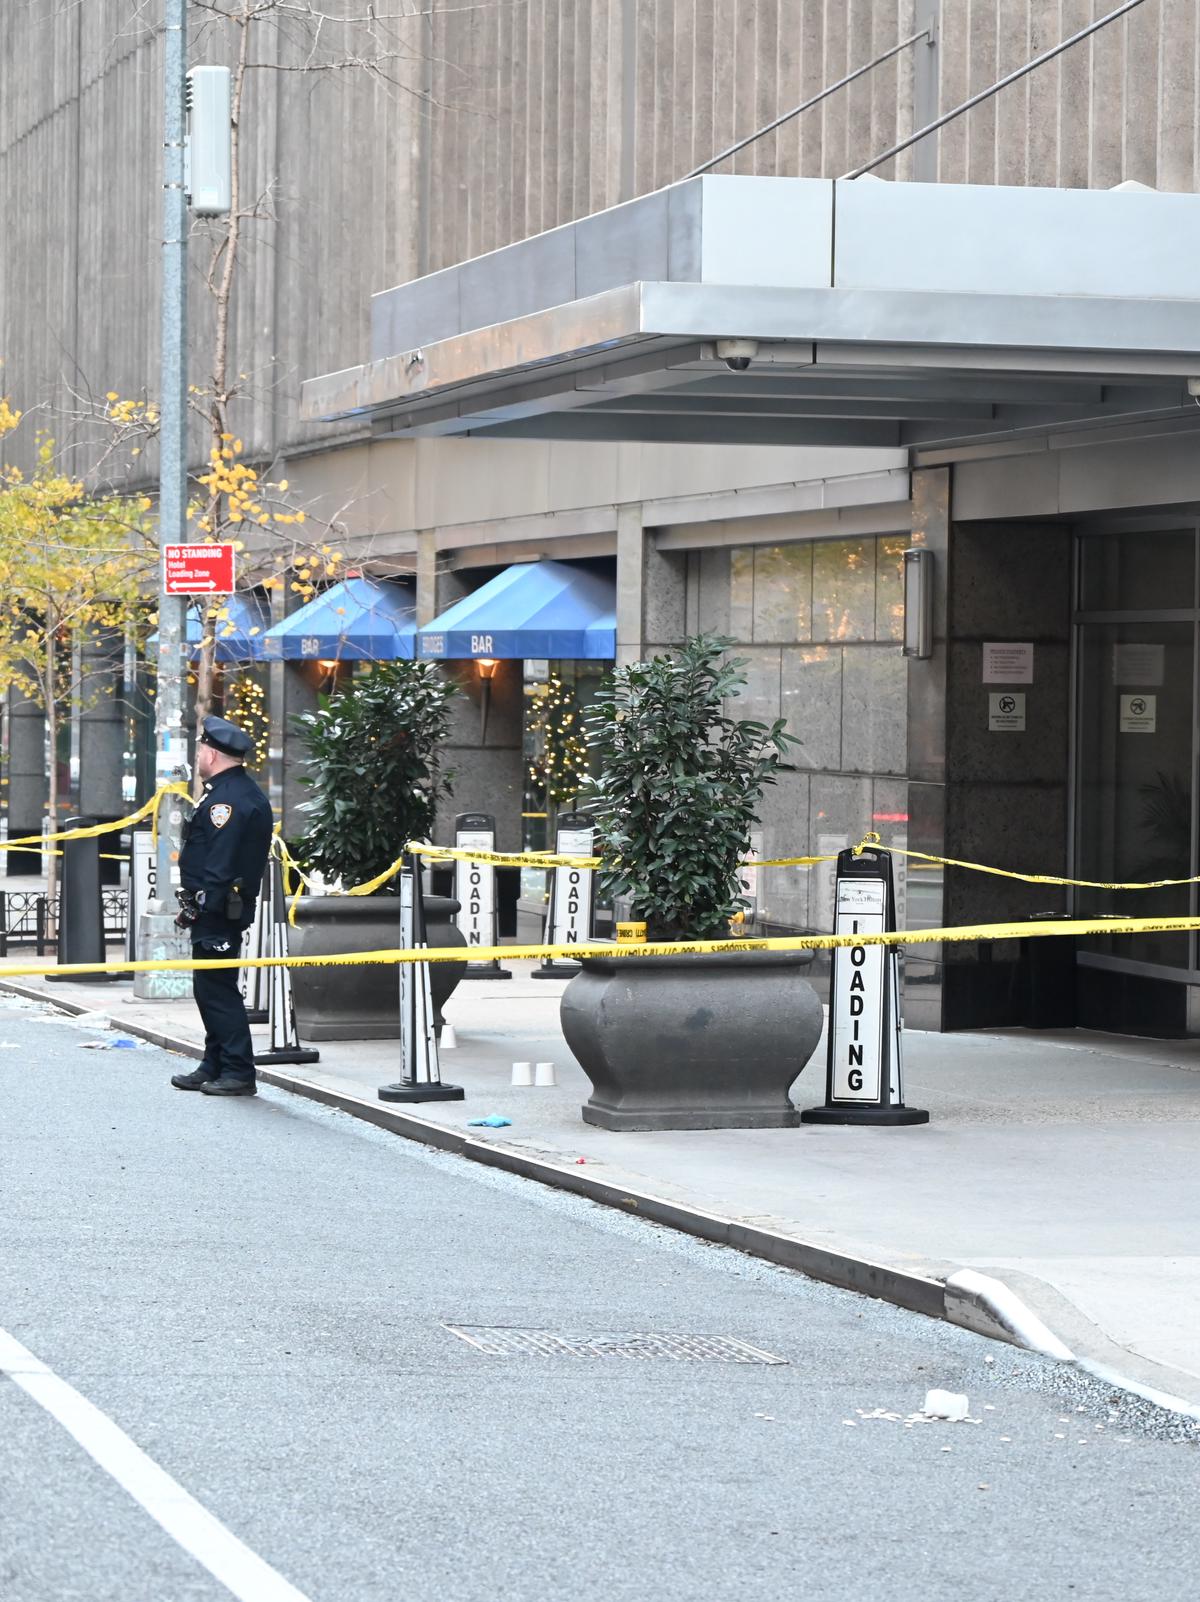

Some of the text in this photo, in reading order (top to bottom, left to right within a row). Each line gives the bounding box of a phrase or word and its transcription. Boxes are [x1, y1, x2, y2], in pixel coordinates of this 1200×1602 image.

[168, 548, 222, 558] NO STANDING
[168, 561, 185, 569] Hotel
[168, 570, 193, 578] Loading
[301, 639, 319, 655] BAR
[472, 635, 492, 653] BAR
[470, 862, 480, 945] LOADIN
